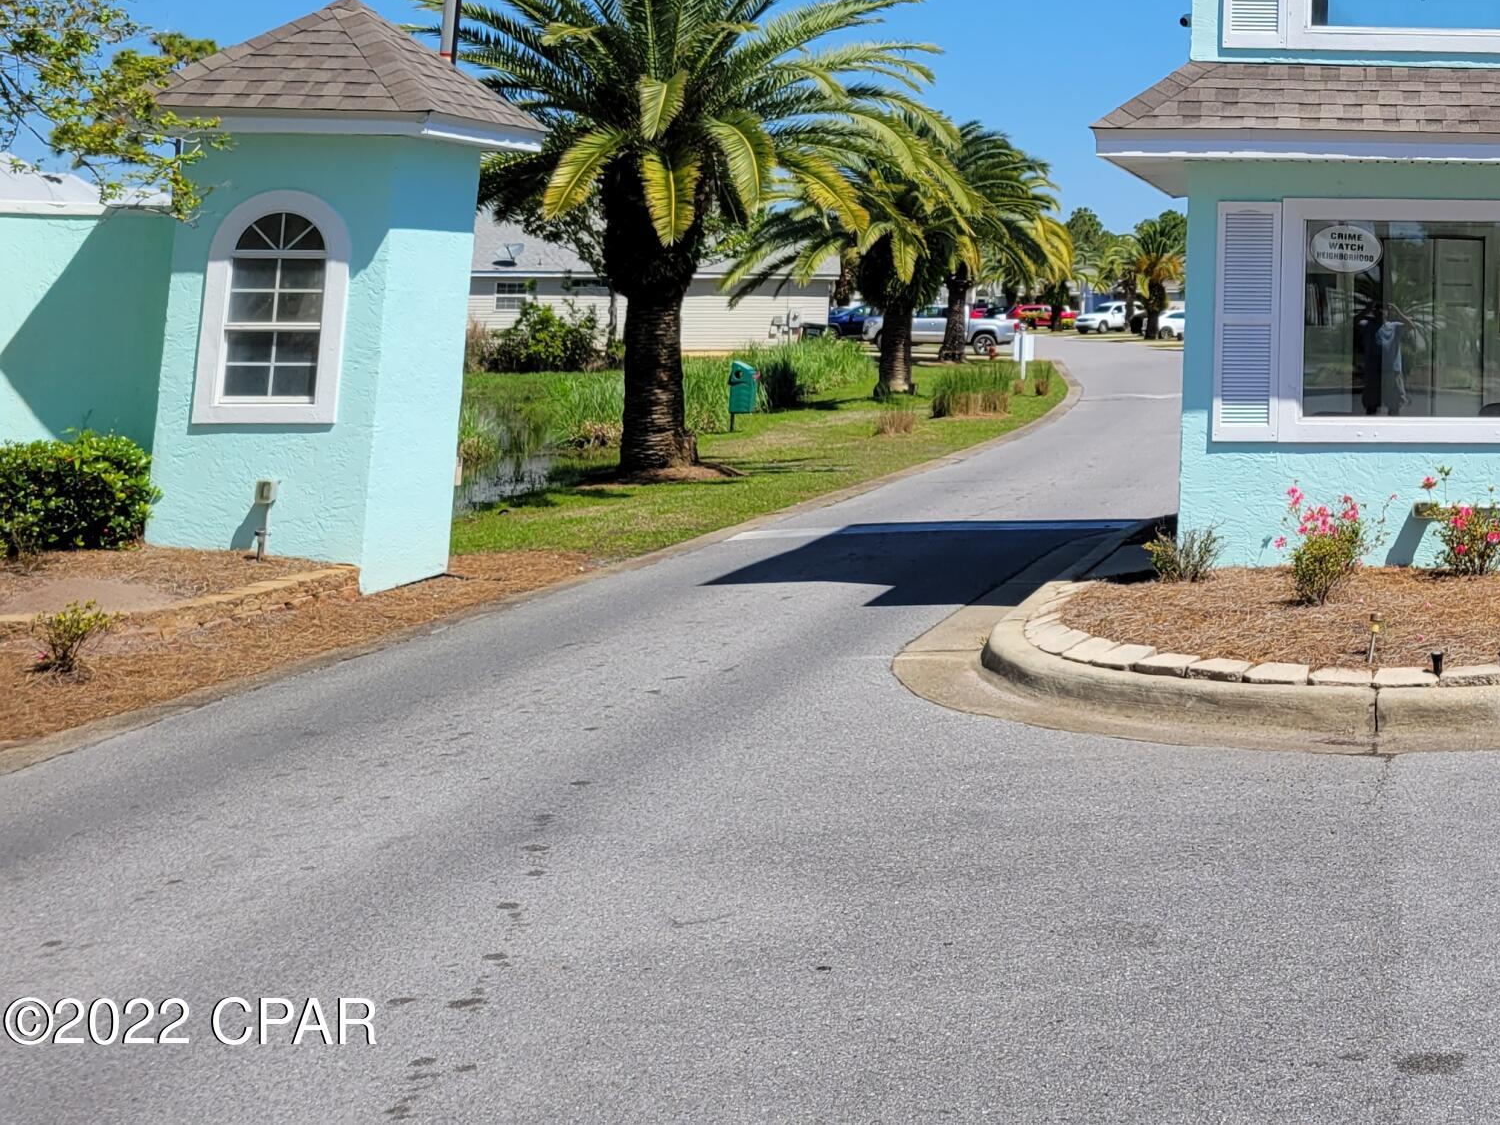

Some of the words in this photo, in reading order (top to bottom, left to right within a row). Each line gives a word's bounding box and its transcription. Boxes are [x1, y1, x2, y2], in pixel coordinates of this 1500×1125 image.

[1330, 232, 1364, 241] CRIME
[1328, 242, 1364, 251] WATCH
[1316, 251, 1374, 262] NEIGHBORHOOD
